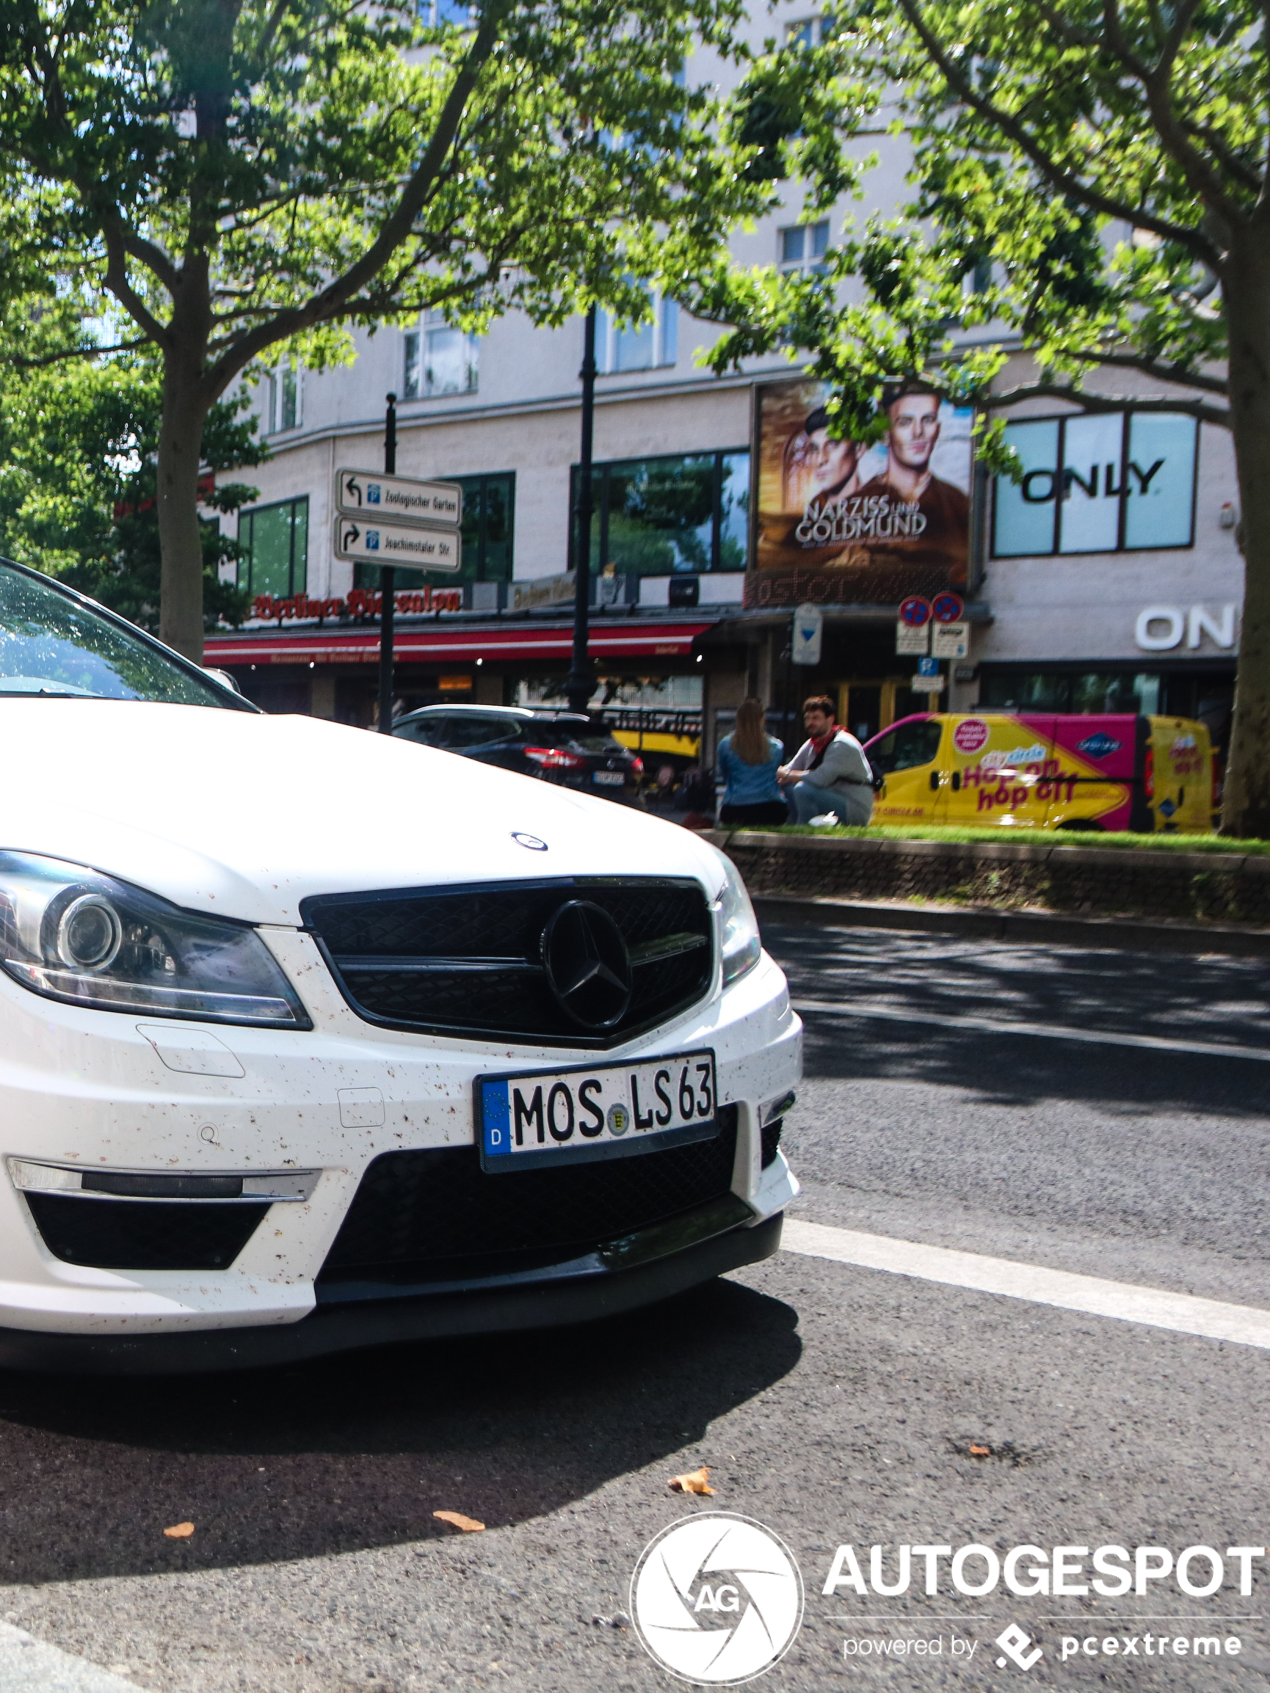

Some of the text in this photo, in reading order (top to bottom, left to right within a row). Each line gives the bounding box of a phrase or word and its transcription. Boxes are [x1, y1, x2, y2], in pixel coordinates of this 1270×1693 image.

[1021, 457, 1165, 504] ONLY
[385, 489, 430, 509] Zoologischer
[433, 496, 456, 512] Garten
[803, 494, 920, 523] NARZISS UND
[795, 511, 928, 543] GOLDMUND
[252, 592, 344, 620] Berliner
[346, 584, 461, 616] Biesalon
[963, 759, 1060, 788] Hop on
[977, 772, 1079, 812] hop off
[513, 1078, 605, 1146] MOS
[491, 1128, 502, 1146] D
